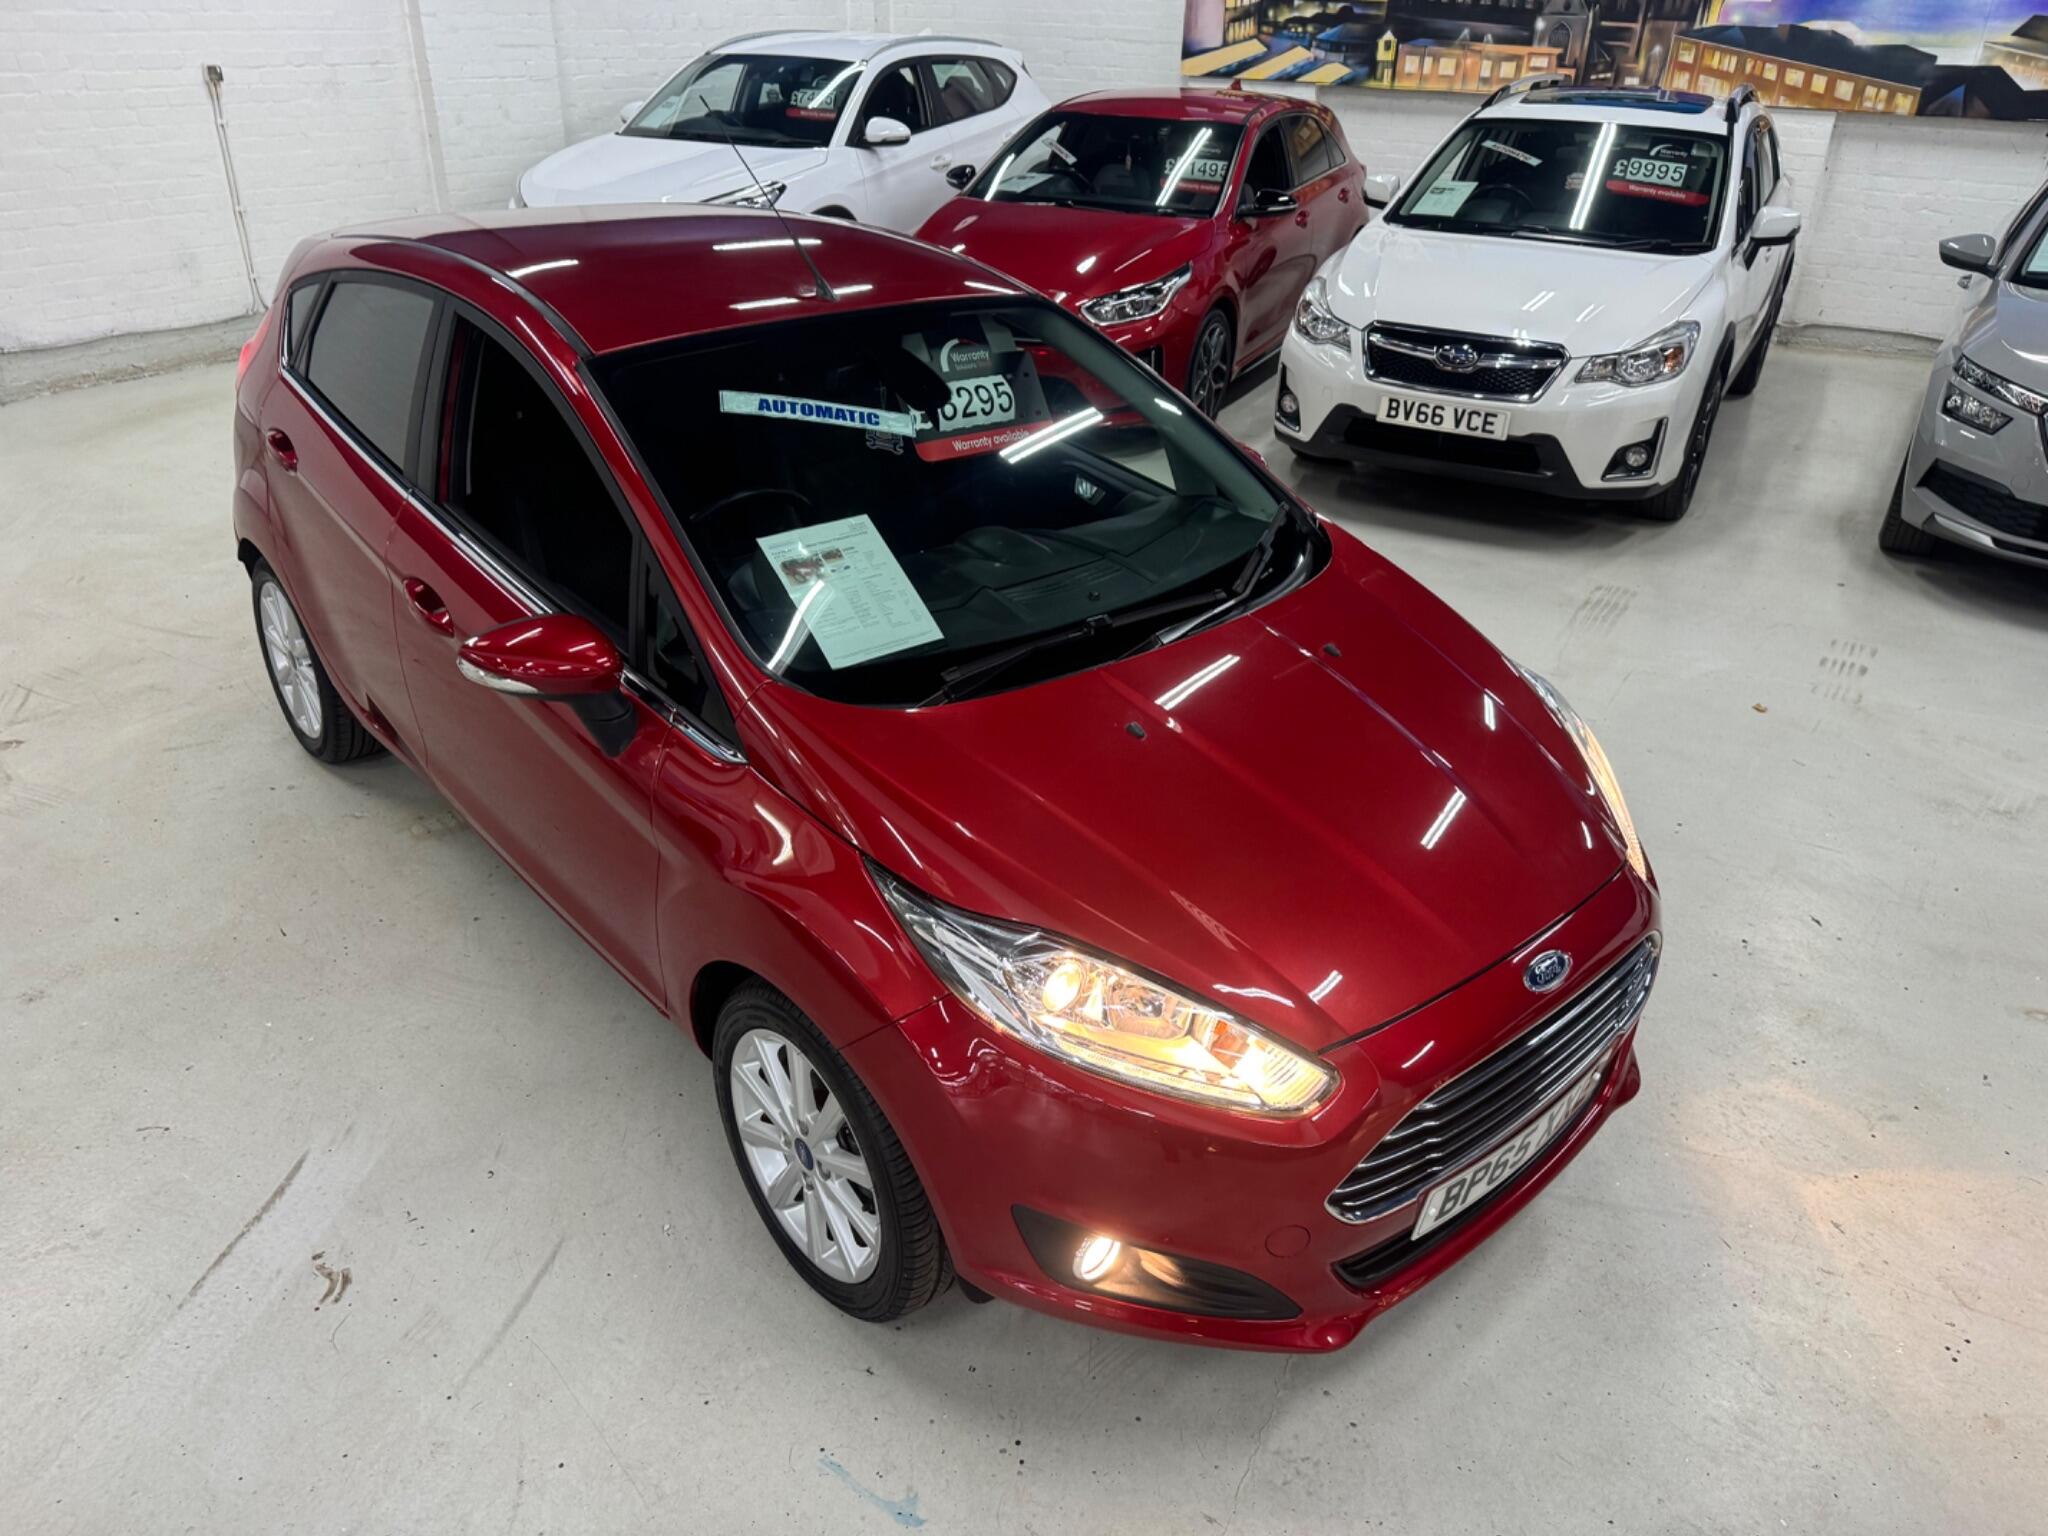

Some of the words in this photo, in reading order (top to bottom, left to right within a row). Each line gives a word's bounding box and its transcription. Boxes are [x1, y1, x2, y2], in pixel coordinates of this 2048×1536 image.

[1613, 159, 1685, 182] £9995
[950, 349, 989, 363] Warranty
[757, 398, 880, 426] AUTOMATIC
[1385, 398, 1445, 426] BV66
[1454, 407, 1498, 434] VCE
[952, 437, 992, 451] Warranty
[993, 430, 1030, 444] available
[1434, 1124, 1540, 1221] BP65
